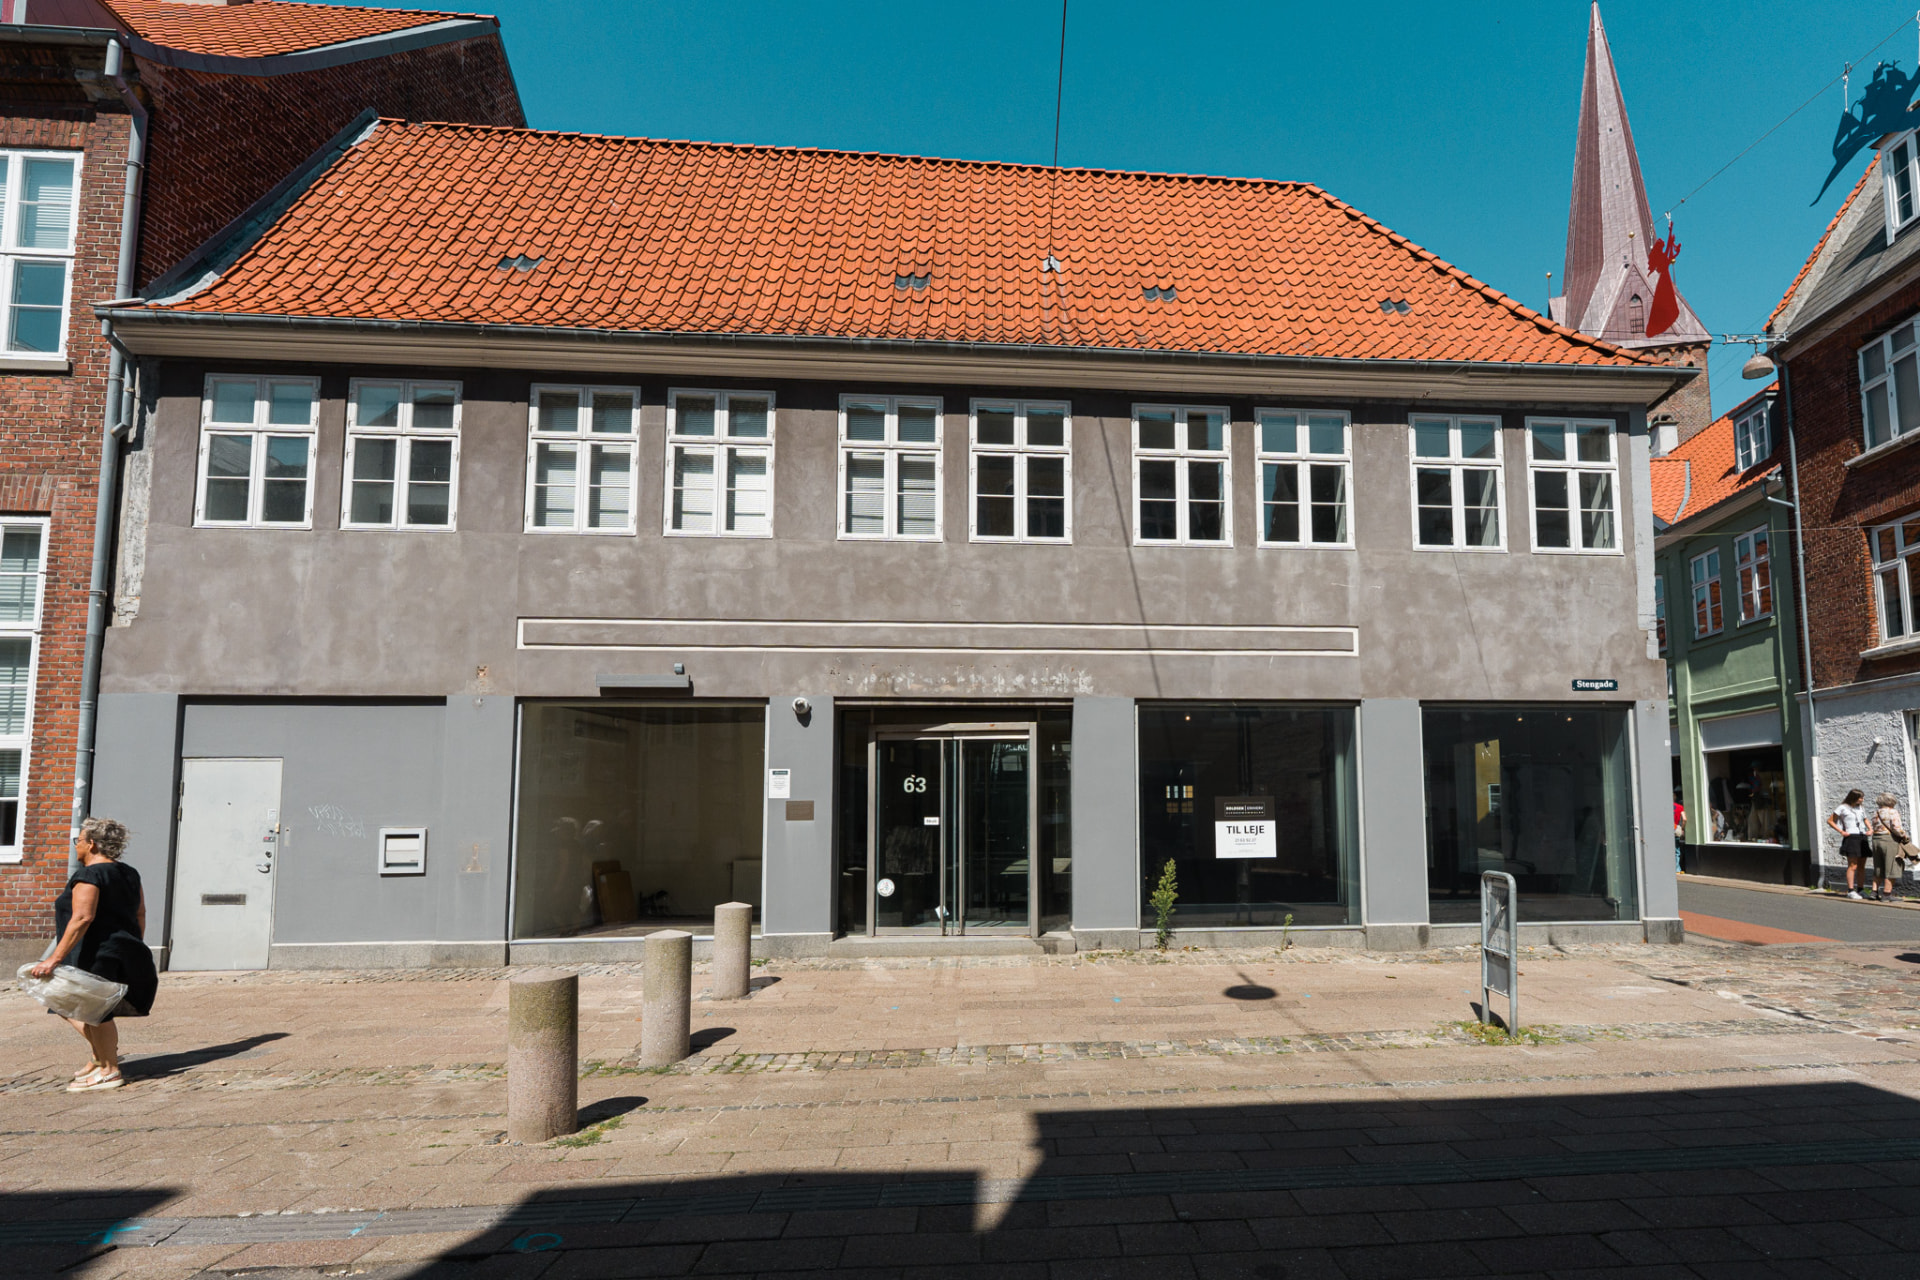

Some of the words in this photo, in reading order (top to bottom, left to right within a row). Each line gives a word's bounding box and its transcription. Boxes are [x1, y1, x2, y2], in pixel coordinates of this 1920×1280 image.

[1577, 680, 1613, 689] Stengade
[903, 777, 926, 793] 63
[1226, 825, 1241, 834] TIL
[1244, 825, 1264, 835] LEJE
